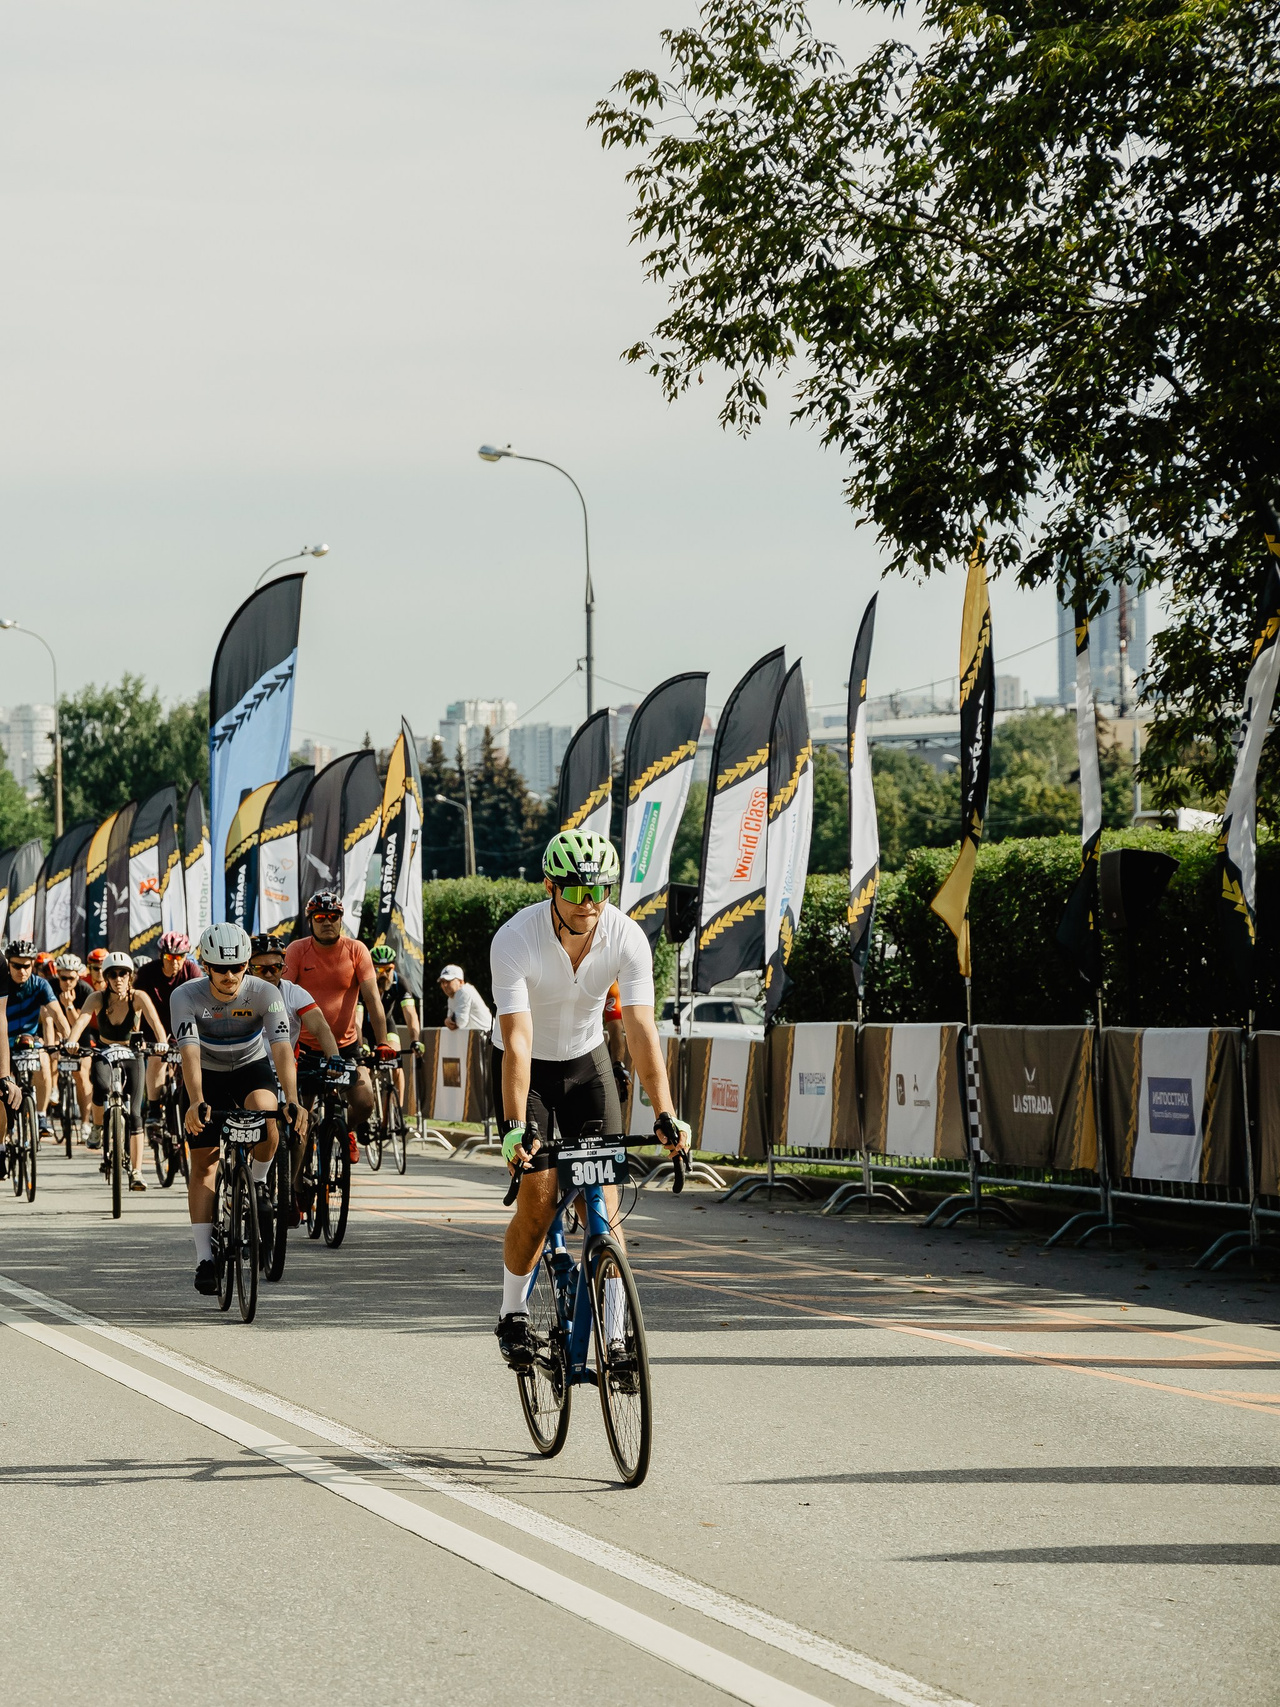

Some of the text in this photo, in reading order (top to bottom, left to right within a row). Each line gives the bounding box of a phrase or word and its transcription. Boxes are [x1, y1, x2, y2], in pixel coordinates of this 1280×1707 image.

[639, 810, 658, 875] Диаспорал
[734, 789, 768, 880] World Class
[383, 833, 397, 893] STRADA
[579, 862, 599, 873] 3014
[235, 864, 247, 916] STRADA
[381, 893, 392, 914] LA
[1013, 1094, 1054, 1115] LA STRADA
[229, 1128, 261, 1142] 3530
[571, 1160, 616, 1186] 3014
